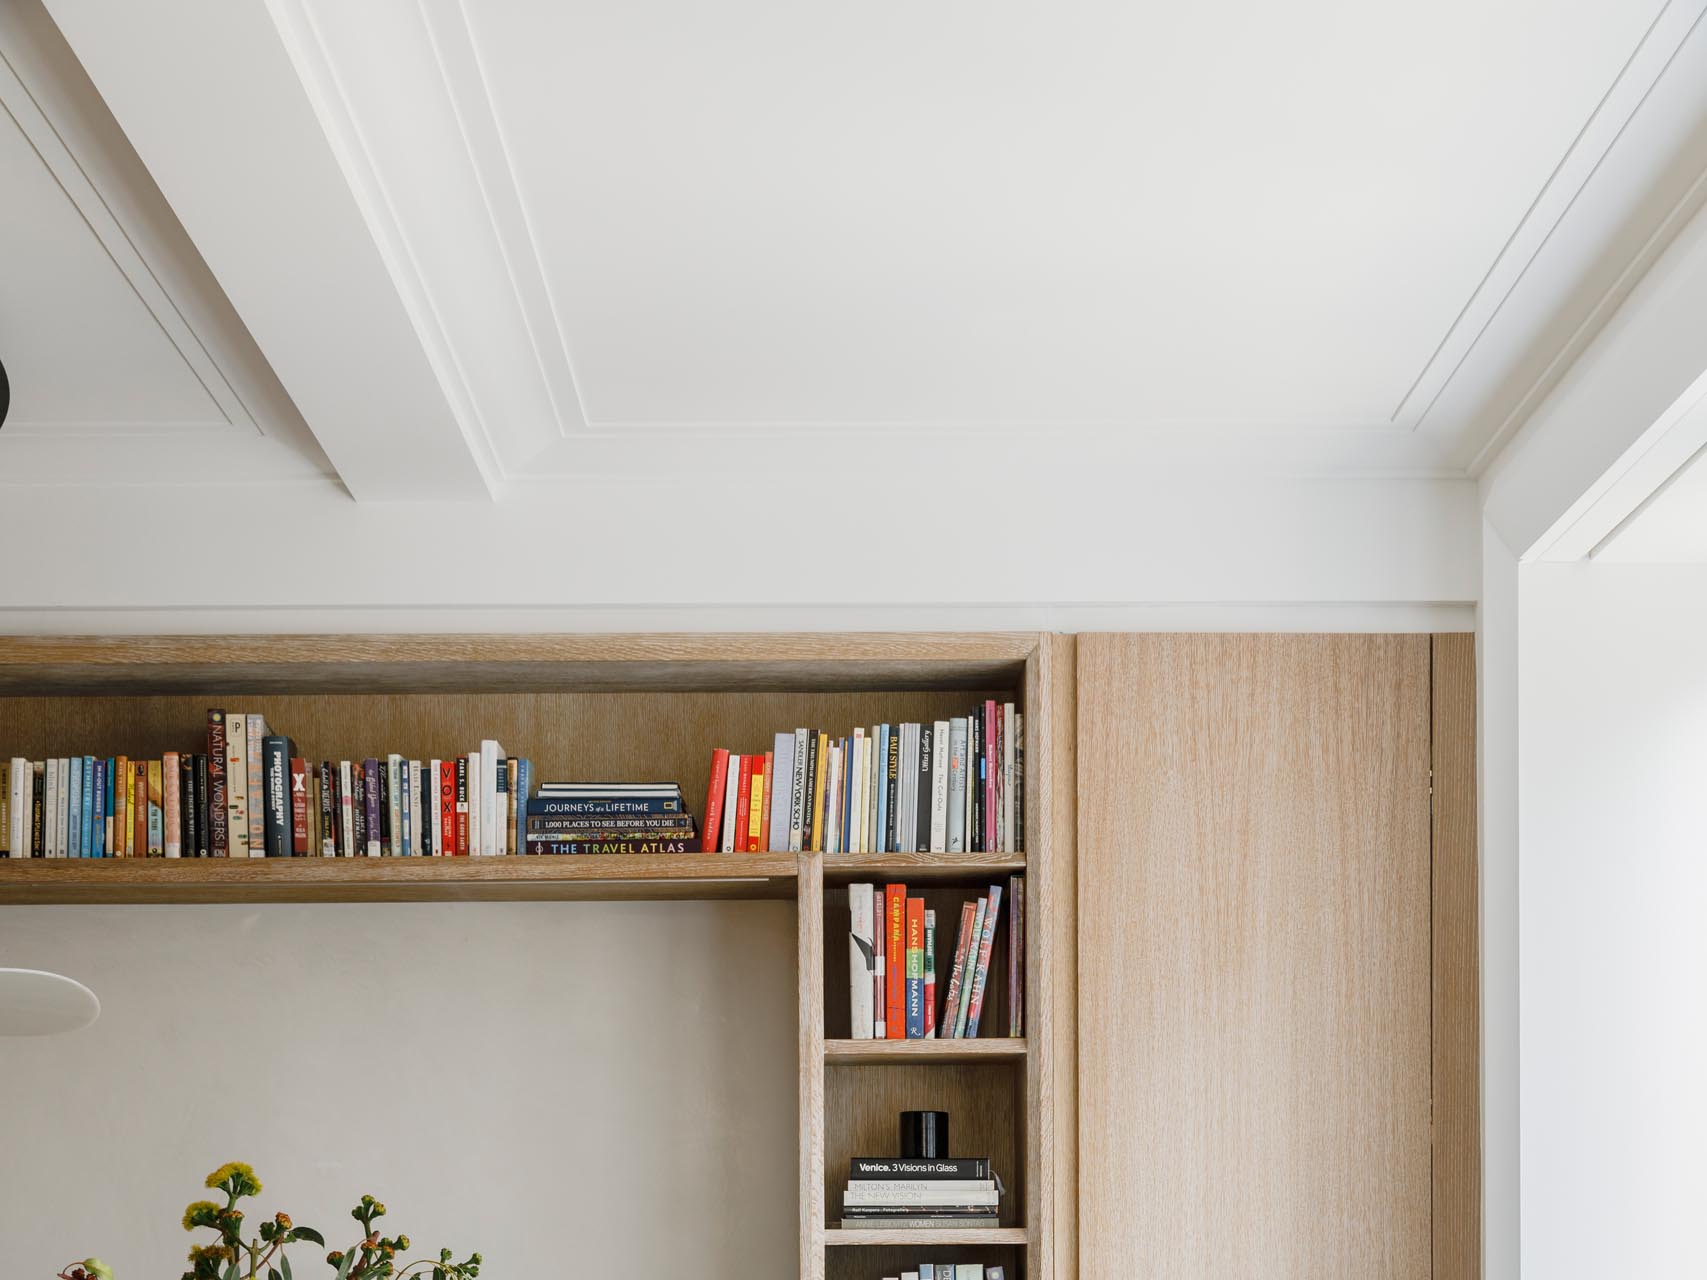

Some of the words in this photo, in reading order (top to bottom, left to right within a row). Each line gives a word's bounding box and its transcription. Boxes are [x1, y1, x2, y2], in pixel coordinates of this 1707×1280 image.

[212, 725, 223, 777] NATURAL
[922, 730, 932, 753] Gallery
[889, 755, 897, 779] STYLE
[274, 752, 284, 825] PHOTOGRAPHY
[213, 781, 225, 841] WONDERS
[544, 803, 594, 812] JOURNEYS
[605, 802, 648, 811] LIFETIME
[646, 820, 661, 828] YOU
[551, 844, 577, 853] THE
[583, 844, 635, 853] TRAVEL
[640, 843, 685, 853] ATLAS
[980, 917, 993, 957] WOLF
[971, 962, 985, 1005] KAHN
[860, 1163, 891, 1172] Venice.
[892, 1164, 898, 1172] 3
[899, 1163, 927, 1172] Visions
[928, 1164, 935, 1172] in
[936, 1164, 957, 1172] Glass
[851, 1192, 867, 1200] THE
[870, 1192, 889, 1200] NEW
[892, 1192, 921, 1200] VISION
